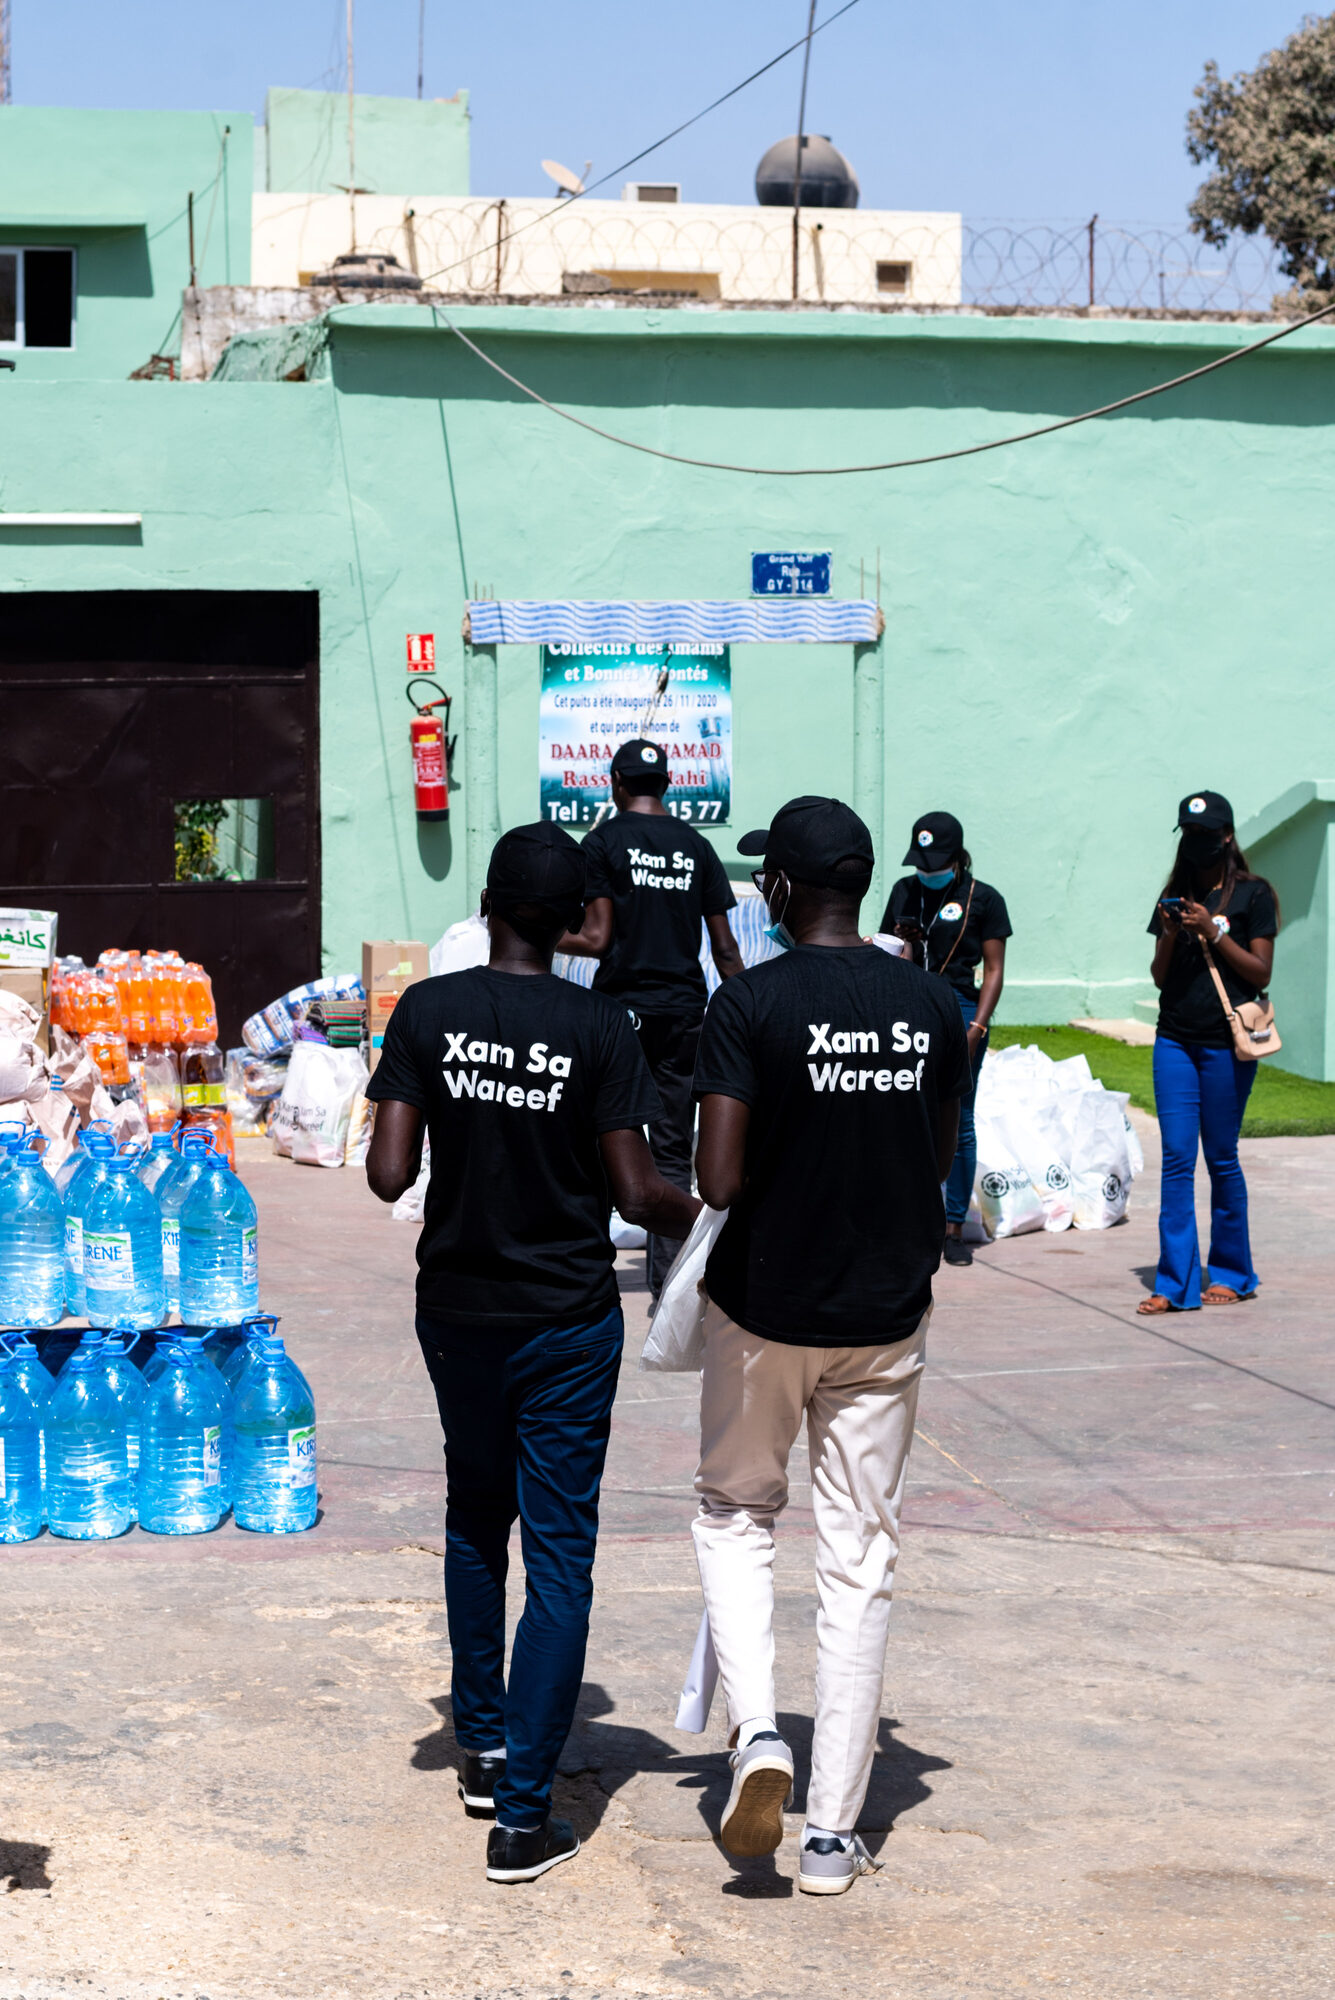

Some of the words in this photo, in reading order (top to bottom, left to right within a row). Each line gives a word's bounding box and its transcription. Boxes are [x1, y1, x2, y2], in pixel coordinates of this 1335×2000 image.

[781, 565, 800, 577] Rue
[564, 666, 580, 681] et
[583, 665, 638, 681] Bonnes
[554, 694, 568, 708] Cet
[570, 693, 591, 711] puits
[590, 721, 598, 733] et
[600, 719, 614, 736] qui
[616, 721, 639, 736] porte
[670, 719, 680, 733] de
[551, 744, 613, 759] DAARA
[562, 771, 612, 787] Rass
[547, 800, 577, 821] Tel
[668, 801, 692, 820] 15
[697, 801, 722, 820] 77
[627, 848, 666, 868] Xam
[672, 851, 695, 871] Sa
[631, 868, 692, 891] Wareef
[806, 1023, 879, 1055] Xam
[892, 1021, 930, 1054] Sa
[442, 1032, 515, 1069] Xam
[525, 1042, 572, 1078] Sa
[807, 1058, 925, 1092] Wareef
[442, 1069, 564, 1112] Wareef
